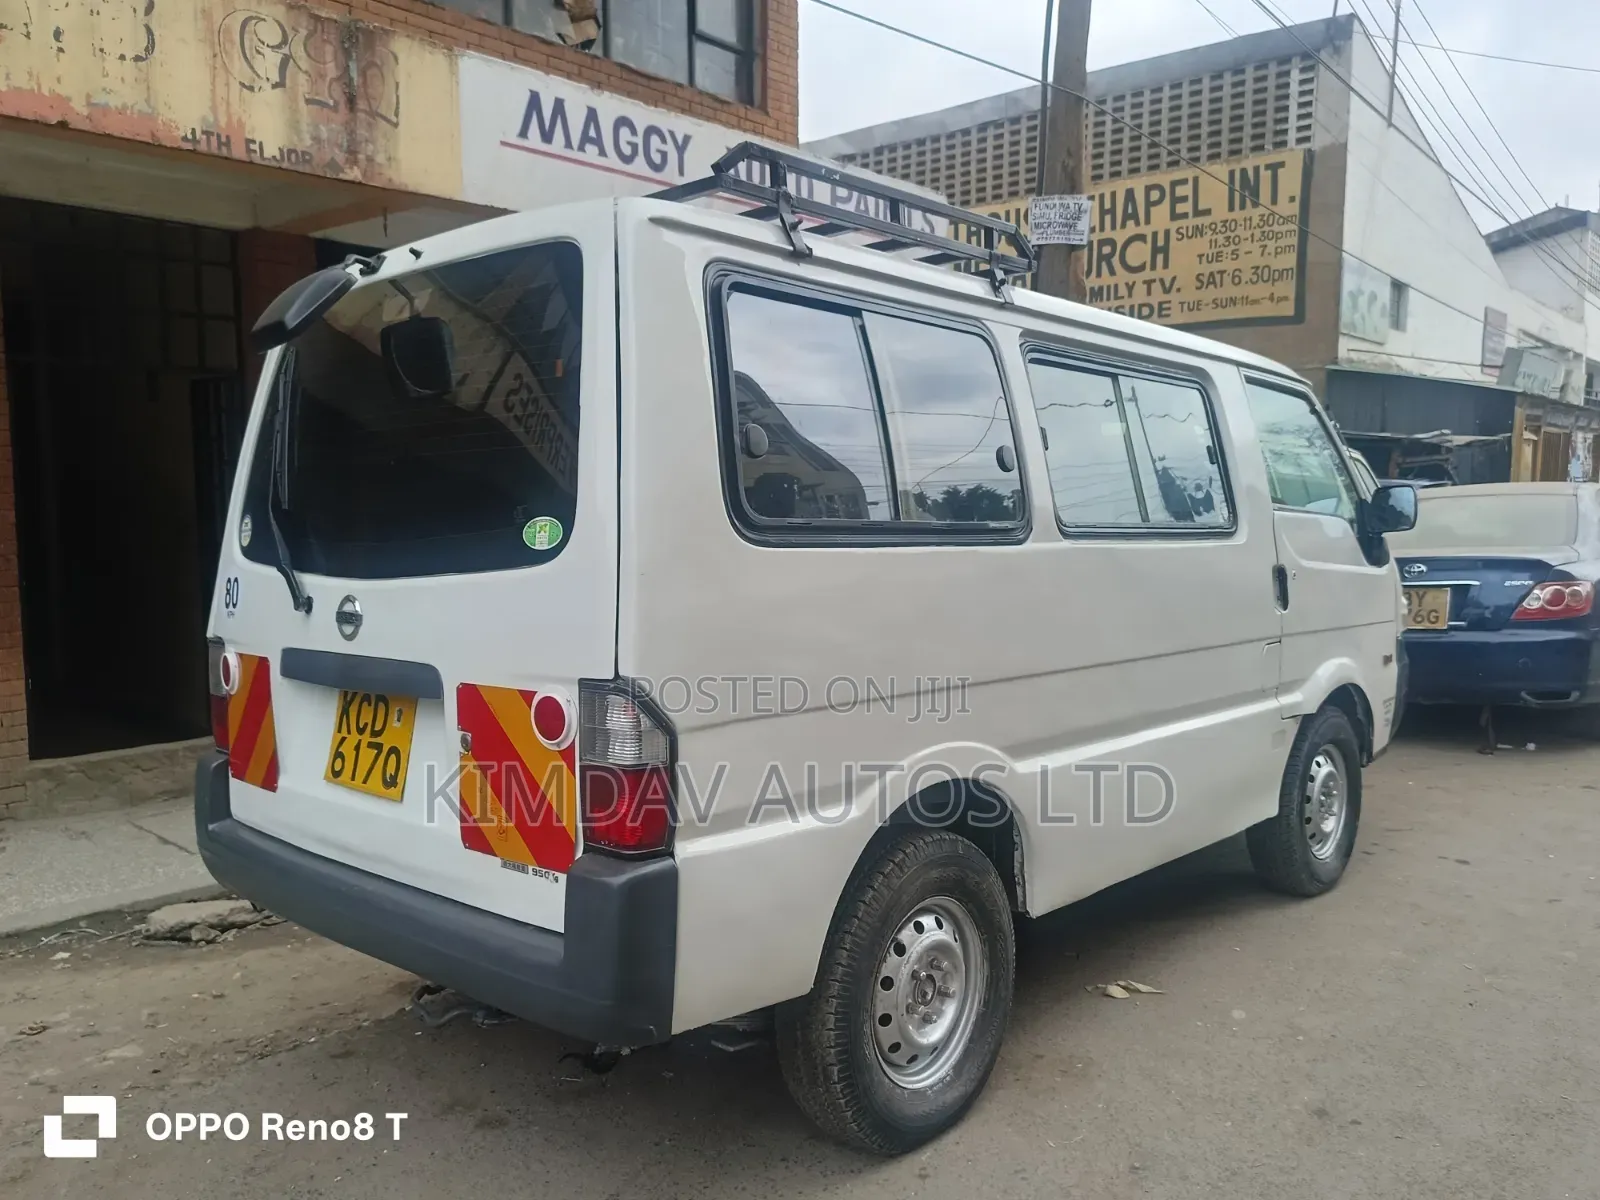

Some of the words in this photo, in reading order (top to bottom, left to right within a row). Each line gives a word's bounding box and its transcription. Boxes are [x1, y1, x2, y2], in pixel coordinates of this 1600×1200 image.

[181, 127, 232, 156] 4TH
[516, 88, 692, 177] MAGGY
[1227, 161, 1296, 213] INT.
[1033, 221, 1079, 231] MICROWAVE
[1142, 275, 1181, 296] TV.
[1101, 300, 1172, 320] SIDE
[224, 576, 239, 609] 80
[337, 690, 389, 738] KCD
[331, 736, 402, 790] 617Q
